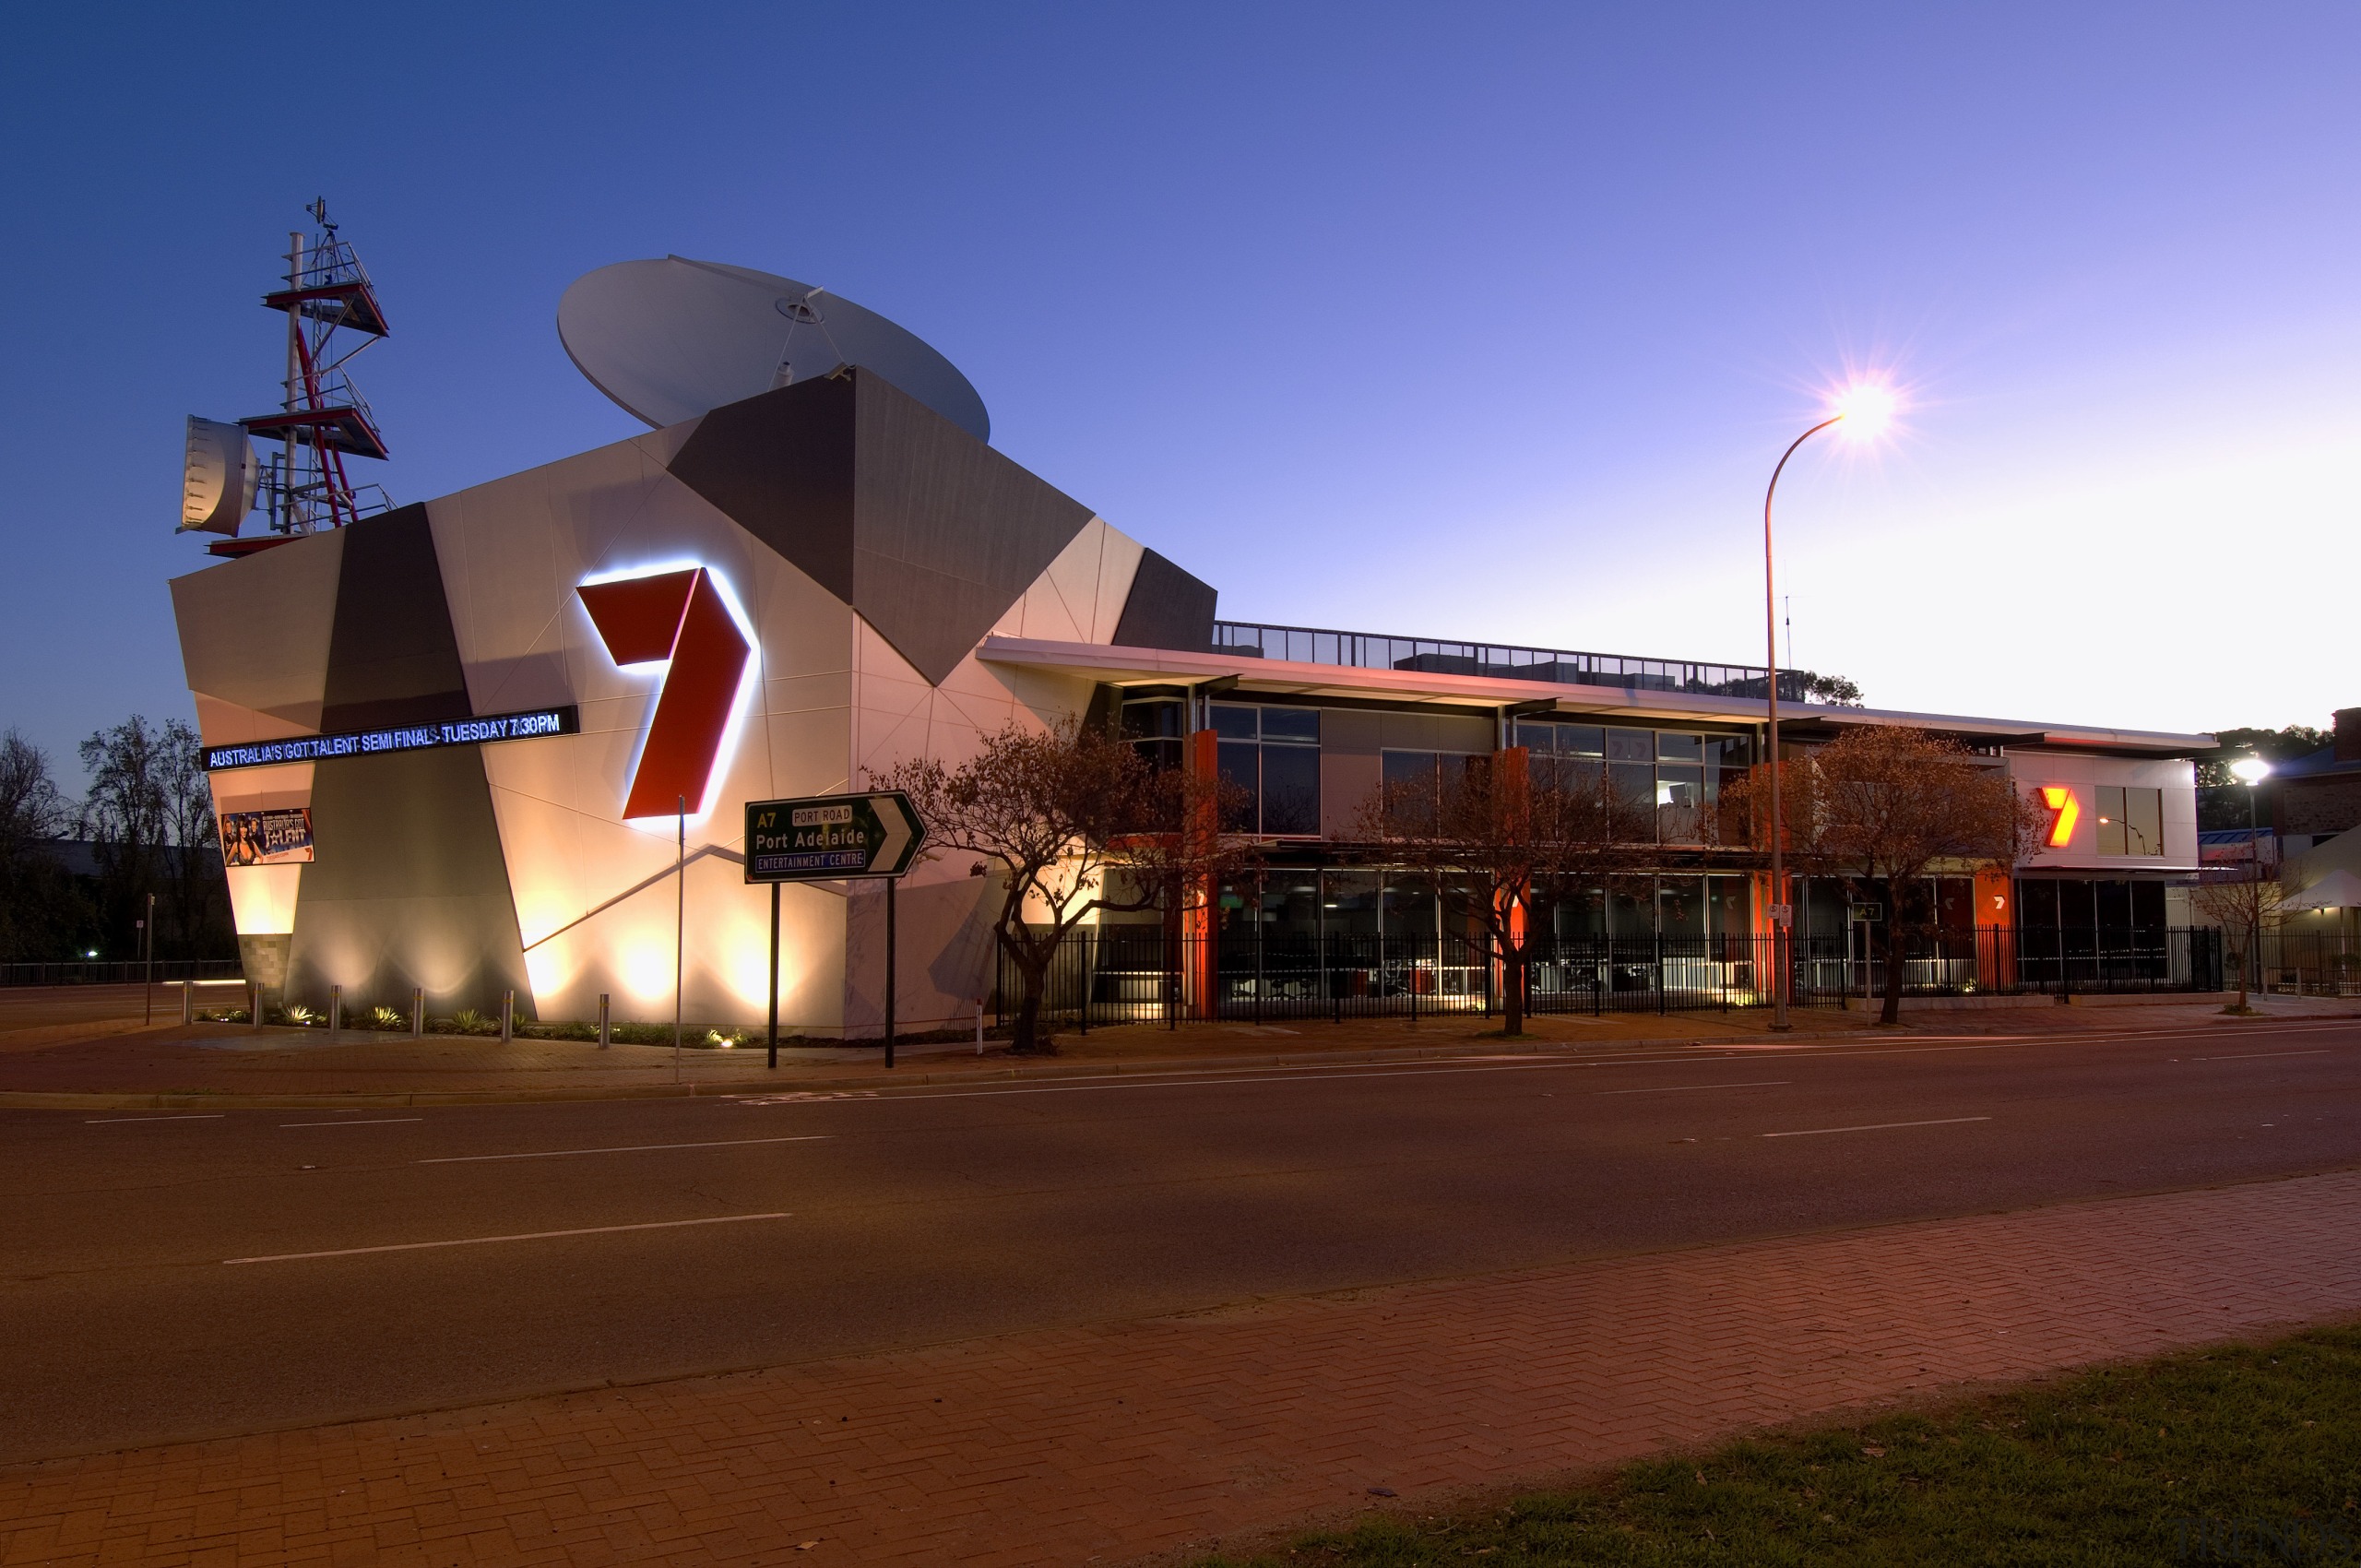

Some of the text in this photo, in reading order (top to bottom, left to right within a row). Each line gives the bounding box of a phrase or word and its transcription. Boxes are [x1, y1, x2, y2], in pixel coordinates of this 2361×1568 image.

[576, 567, 752, 819] 7
[210, 745, 282, 767] AUSTRALIA'S
[286, 742, 312, 759] GOT
[312, 737, 359, 756] TALENT
[362, 732, 393, 751] SEMI
[442, 720, 507, 742] TUESDAY
[757, 813, 777, 828] A7
[794, 808, 849, 824] PORT ROAD
[2036, 788, 2080, 847] 7
[756, 829, 864, 849] Port Adelaide
[758, 852, 863, 870] ENTERTAINMENT CENTRE
[1859, 908, 1875, 916] A7
